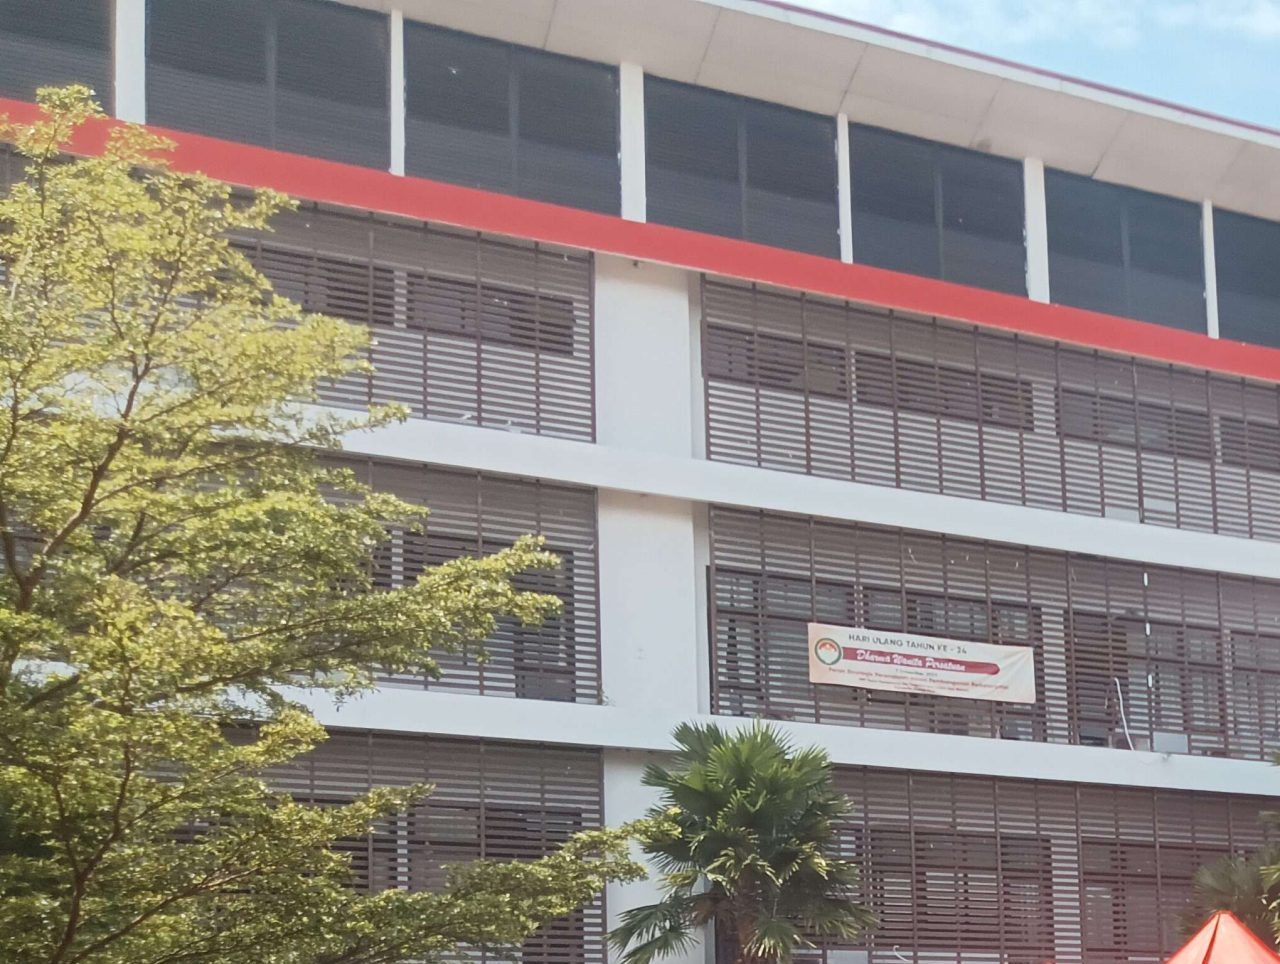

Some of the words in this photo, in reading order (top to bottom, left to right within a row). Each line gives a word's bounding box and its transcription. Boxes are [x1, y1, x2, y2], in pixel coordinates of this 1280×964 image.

[848, 633, 870, 643] HARI
[872, 636, 904, 647] ULANG
[906, 640, 936, 652] TAHUN
[892, 654, 923, 667] Wanita
[925, 657, 966, 673] Persatuan
